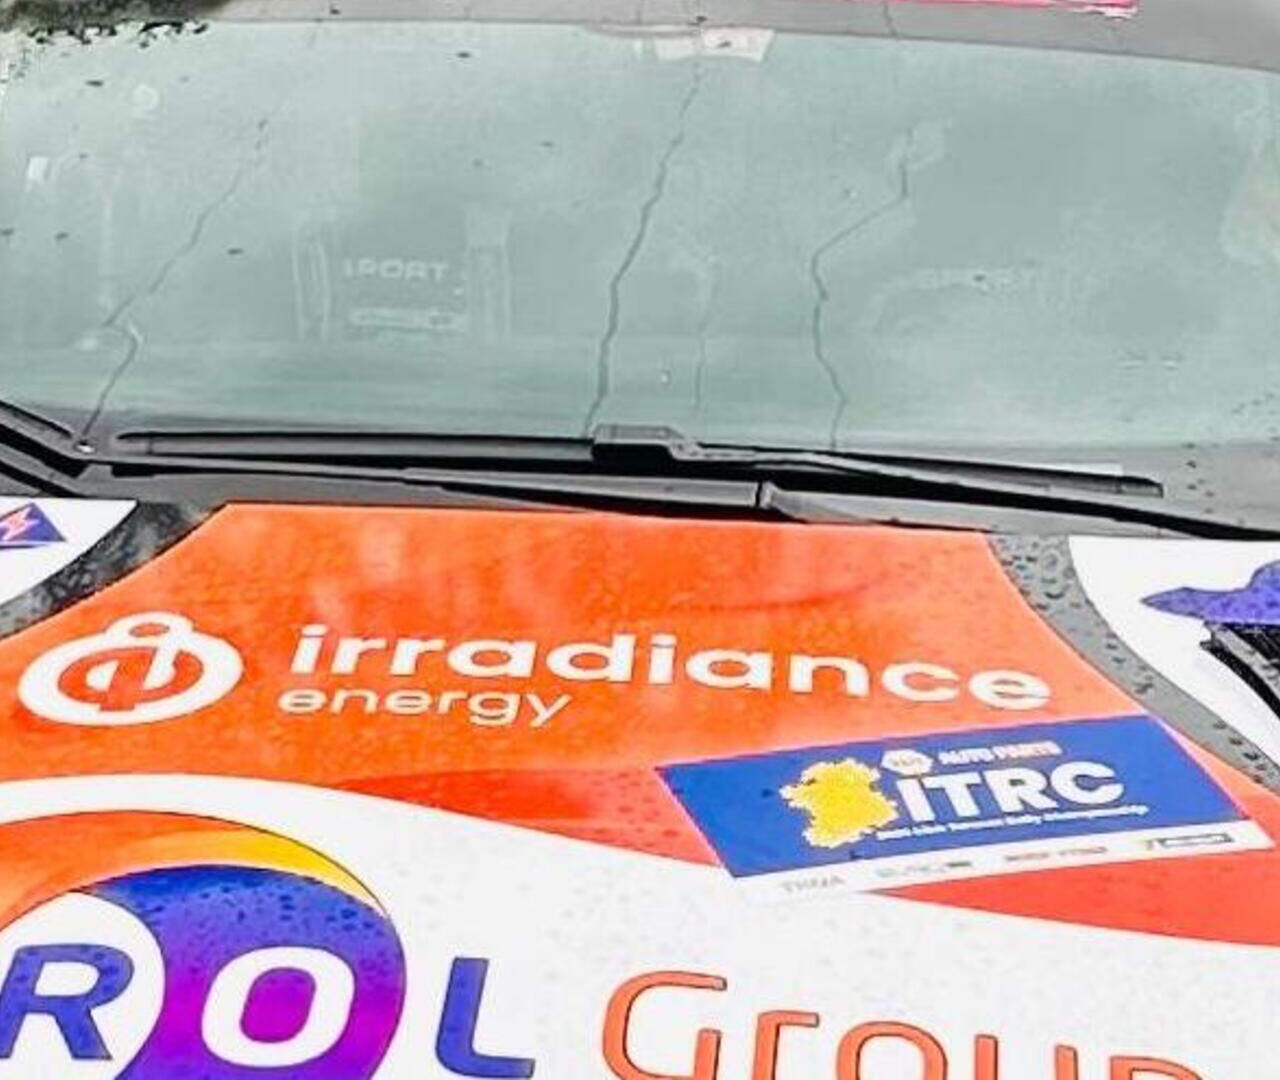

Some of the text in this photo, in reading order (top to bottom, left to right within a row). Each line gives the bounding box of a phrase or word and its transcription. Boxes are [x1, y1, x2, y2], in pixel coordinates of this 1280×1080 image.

[290, 623, 1052, 710] irradiance
[278, 686, 572, 728] energy
[896, 760, 1125, 823] ITRC
